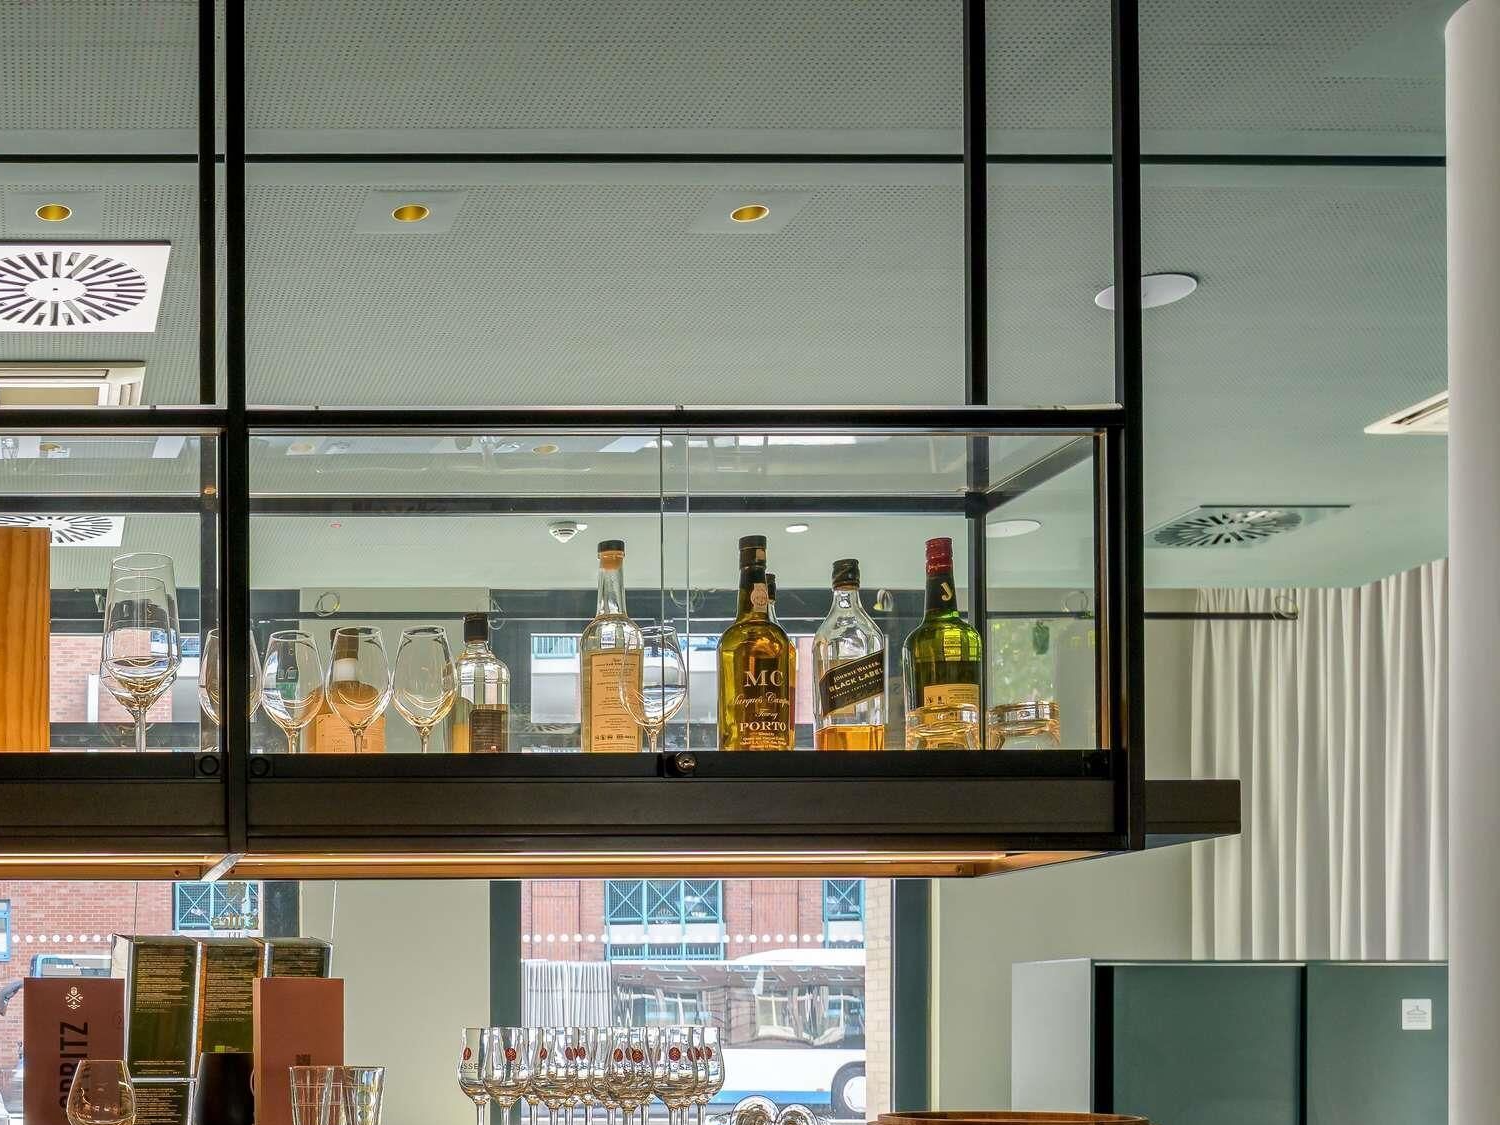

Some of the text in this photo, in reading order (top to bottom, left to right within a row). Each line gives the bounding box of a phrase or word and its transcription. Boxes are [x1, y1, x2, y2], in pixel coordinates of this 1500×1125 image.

[744, 670, 785, 687] MC
[829, 668, 884, 692] BLACK LABEL
[740, 721, 787, 732] PORTO
